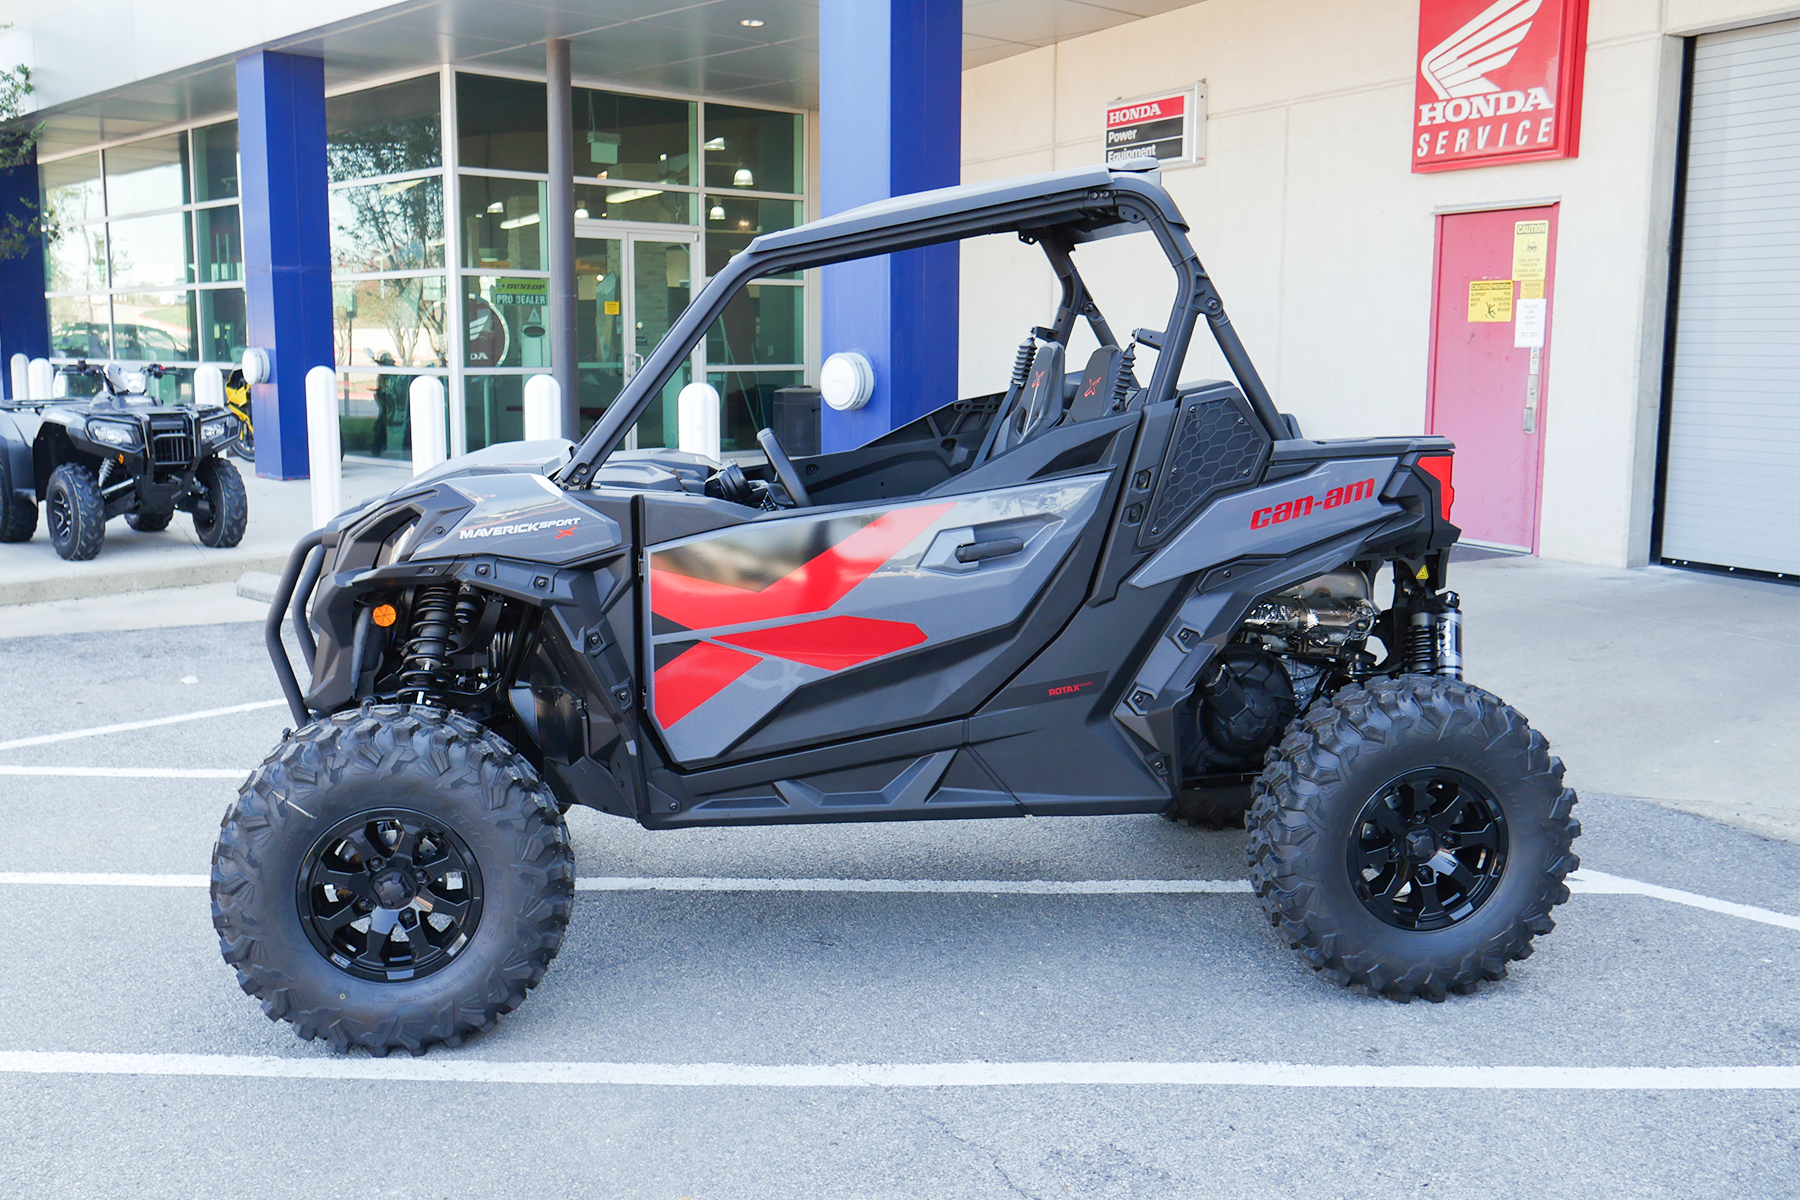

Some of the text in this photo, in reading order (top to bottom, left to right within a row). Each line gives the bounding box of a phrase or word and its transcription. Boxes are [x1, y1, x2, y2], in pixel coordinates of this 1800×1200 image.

[1108, 102, 1162, 125] HONDA
[1418, 86, 1554, 127] HONDA
[1108, 128, 1138, 144] Power
[1416, 117, 1553, 158] SERVICE
[1107, 143, 1157, 163] Equipment
[1517, 224, 1546, 234] CAUTION
[497, 294, 546, 304] PRO DEALER
[1250, 477, 1375, 531] can-am
[459, 517, 581, 540] MAVERICK SPORT
[1436, 619, 1452, 658] FOX
[1048, 684, 1080, 697] ROTAX
